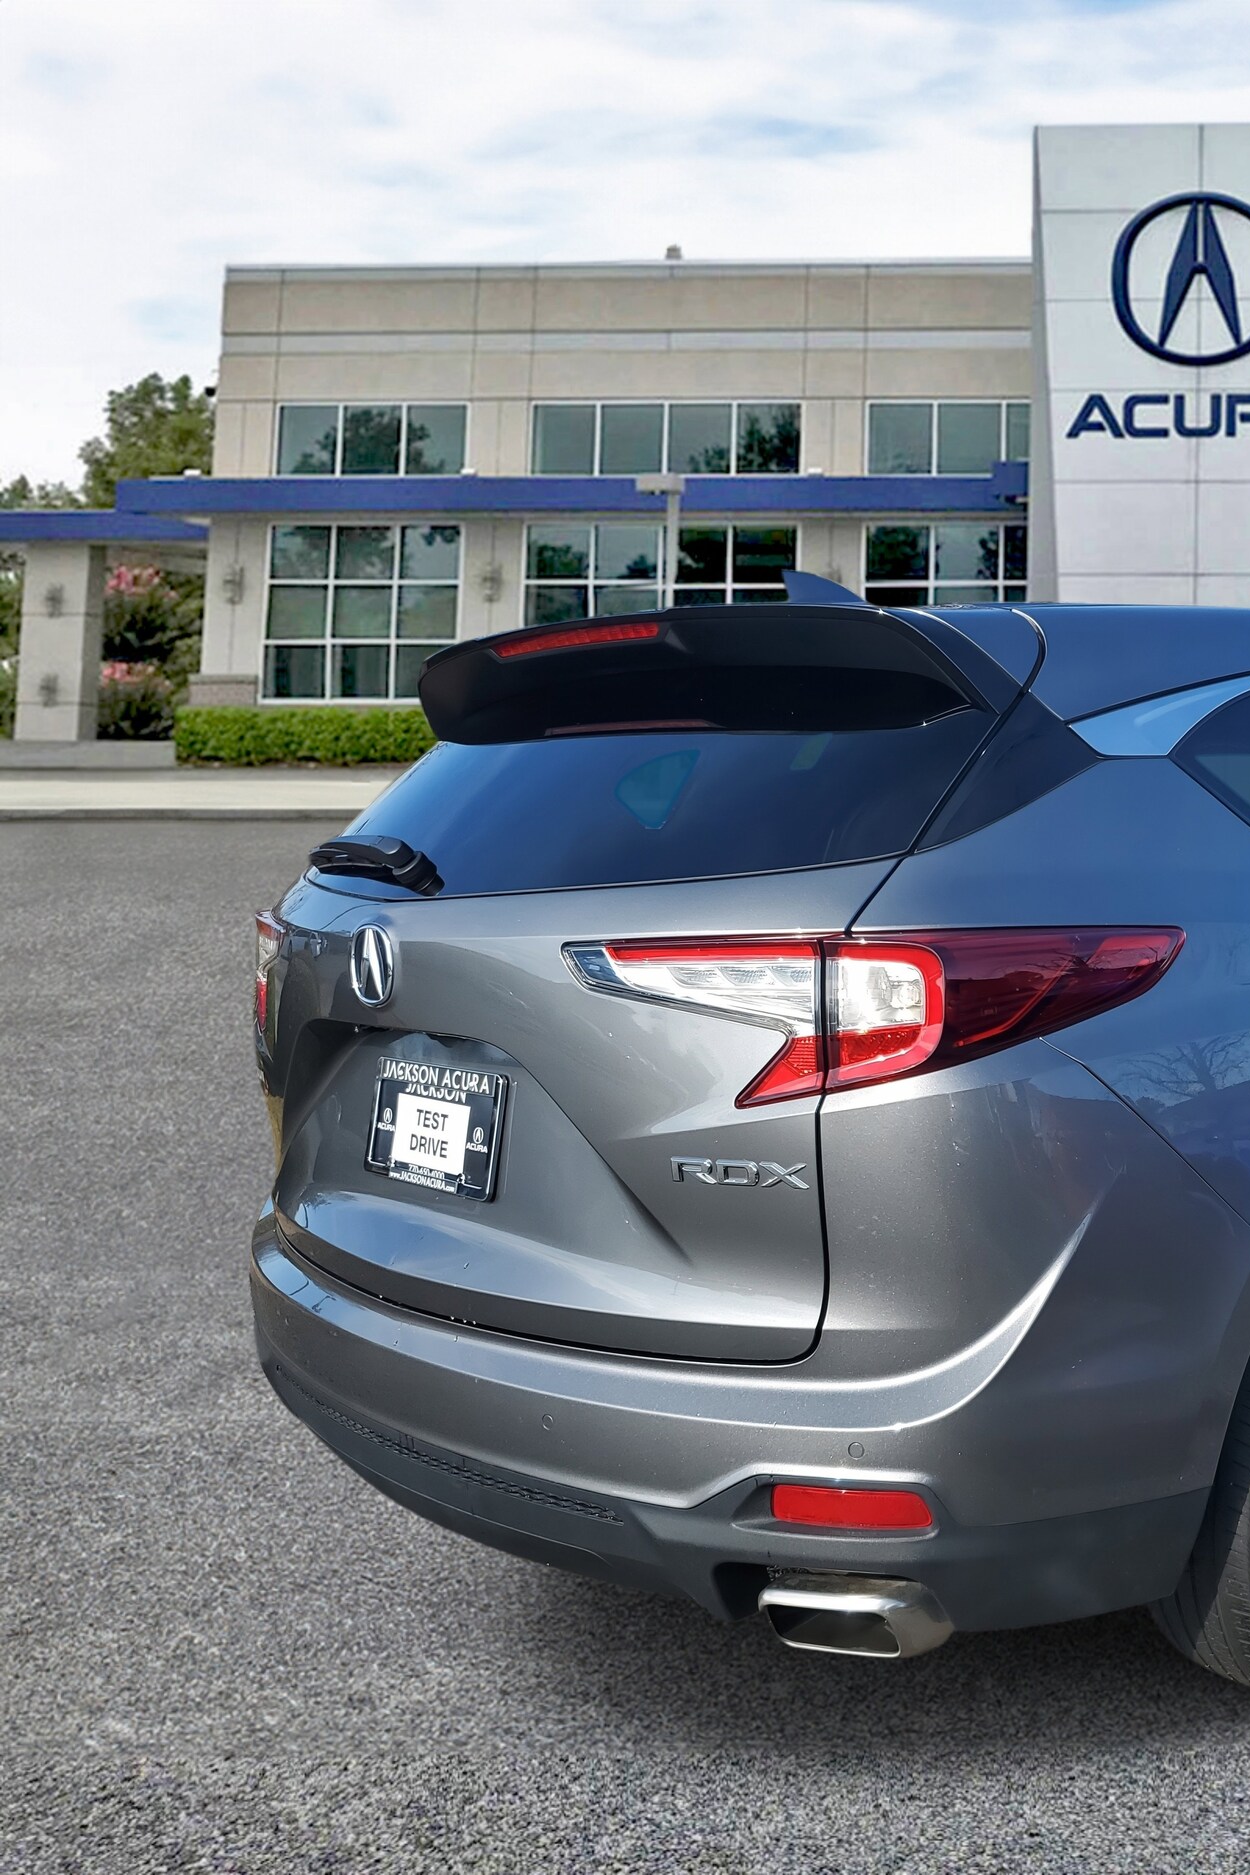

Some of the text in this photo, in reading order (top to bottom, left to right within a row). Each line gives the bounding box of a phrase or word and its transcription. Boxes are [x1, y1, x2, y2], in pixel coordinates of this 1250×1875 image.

[384, 1060, 490, 1094] JACKSON ACURA
[377, 1122, 395, 1132] ACURA
[417, 1108, 449, 1131] TEST
[410, 1133, 449, 1158] DRIVE
[466, 1142, 488, 1153] ACURA
[670, 1155, 810, 1190] RDX
